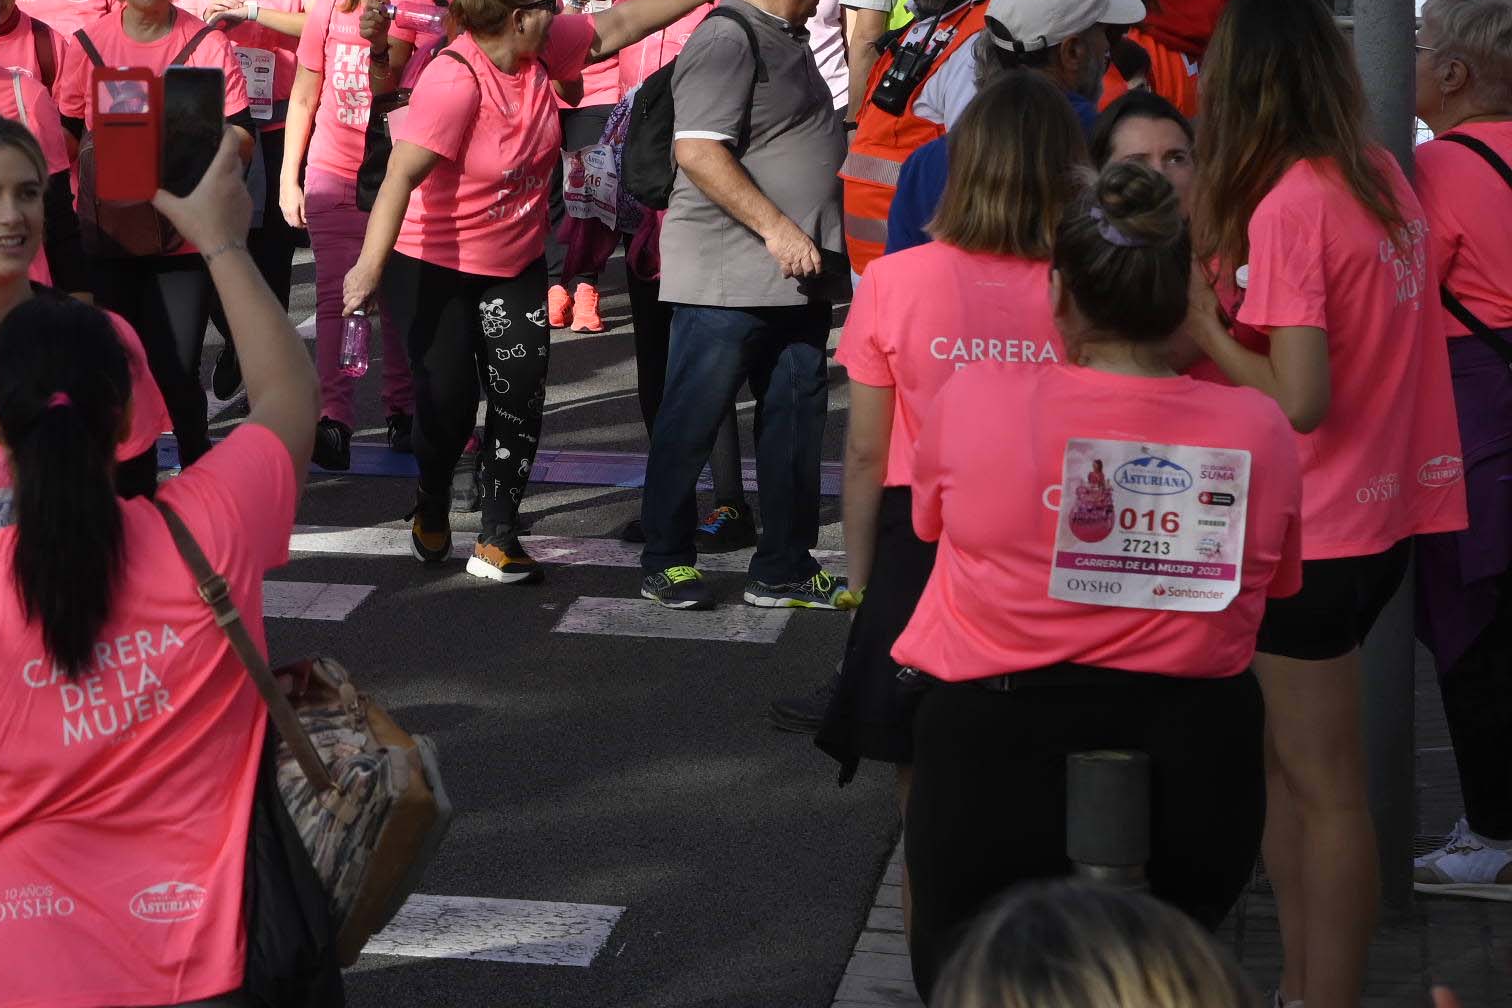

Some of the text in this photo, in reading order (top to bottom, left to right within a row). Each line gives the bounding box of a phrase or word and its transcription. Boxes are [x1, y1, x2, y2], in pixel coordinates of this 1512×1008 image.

[929, 336, 1059, 364] CARRERA
[1119, 469, 1187, 490] ASTURIANA
[1199, 470, 1236, 482] SUMA
[1119, 507, 1181, 534] 016
[1122, 538, 1171, 556] 27213
[1074, 556, 1222, 576] CARRERA DE LA MUJER 2023
[1066, 578, 1123, 594] OYSHO
[1167, 586, 1225, 600] Santander
[60, 661, 162, 714] DE LA
[61, 689, 175, 747] MUJER
